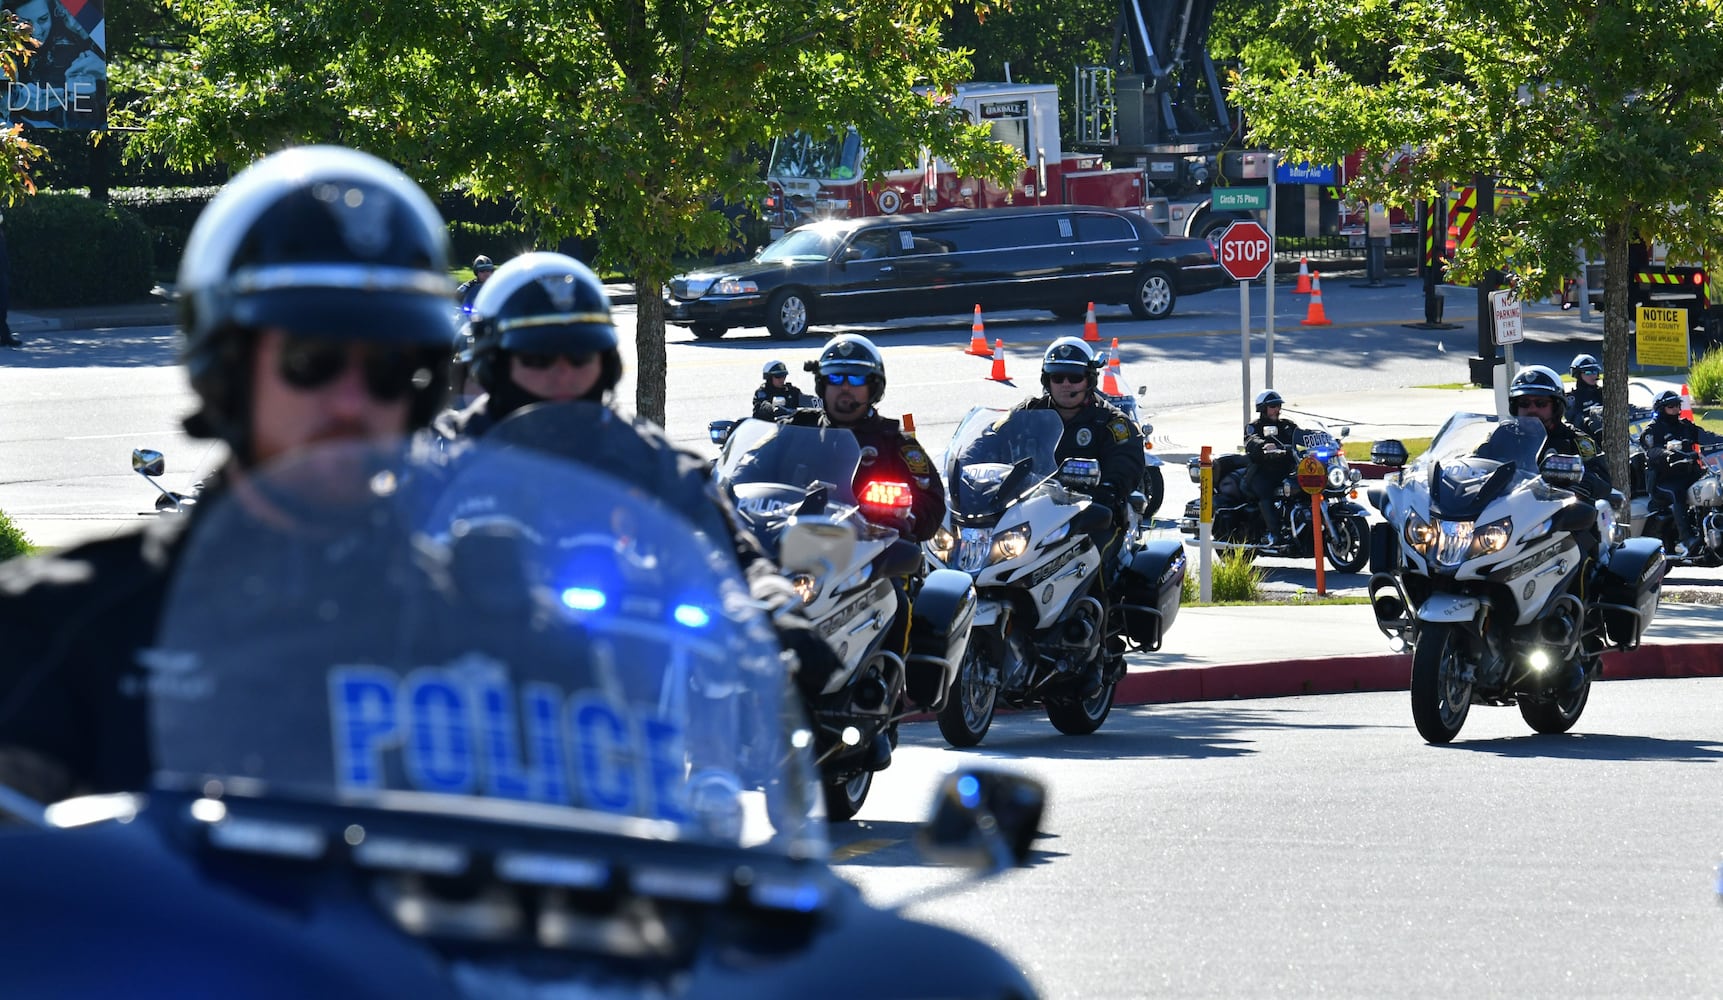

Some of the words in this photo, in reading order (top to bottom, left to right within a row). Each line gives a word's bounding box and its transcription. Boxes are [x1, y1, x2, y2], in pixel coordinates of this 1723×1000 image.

[8, 82, 93, 112] DINE
[985, 104, 1021, 115] OAKDALE
[1289, 168, 1308, 179] Battery
[1310, 168, 1321, 178] Ave
[1219, 194, 1236, 204] Circle
[1236, 194, 1243, 204] 75
[1244, 194, 1259, 205] Pkwy
[1224, 240, 1267, 262] STOP
[1496, 307, 1520, 320] PARKING
[1643, 309, 1678, 322] NOTICE
[1503, 320, 1515, 328] FIRE
[1658, 322, 1680, 330] COUNTY
[1503, 329, 1516, 338] LANE
[1032, 544, 1081, 585] POLICE
[1511, 542, 1562, 577] POLICE
[329, 664, 689, 824] POLICE
